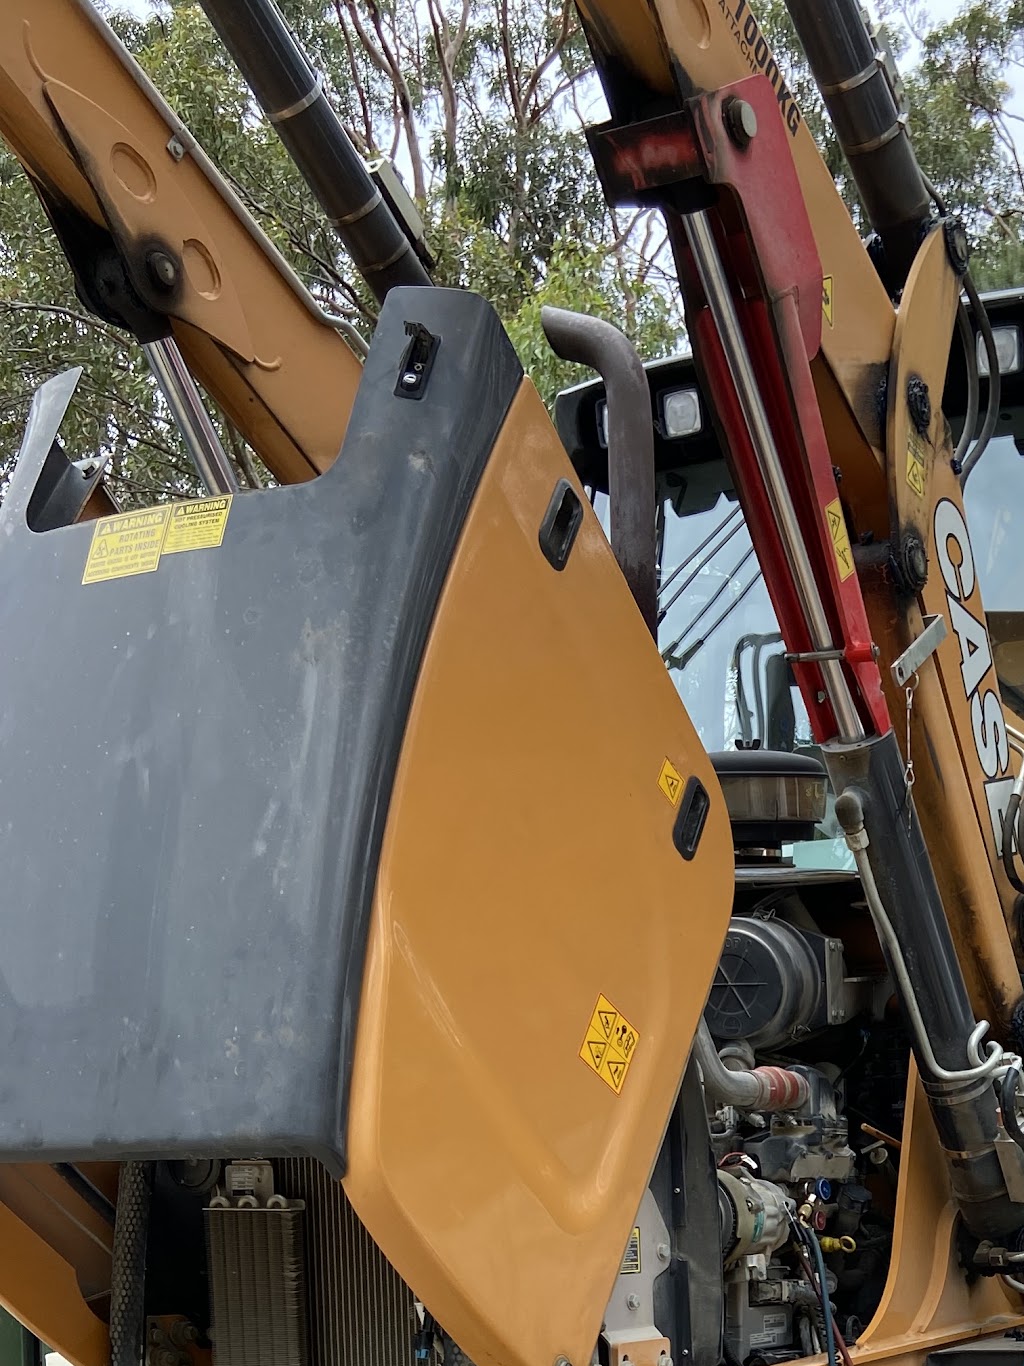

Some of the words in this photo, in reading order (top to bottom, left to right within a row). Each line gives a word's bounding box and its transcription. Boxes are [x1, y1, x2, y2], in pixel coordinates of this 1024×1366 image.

[186, 499, 227, 513] WARNING
[113, 512, 163, 533] WARNING
[118, 528, 156, 543] ROTATING
[109, 544, 132, 557] PARTS
[134, 540, 160, 551] INSIDE
[934, 497, 1019, 858] CASE
